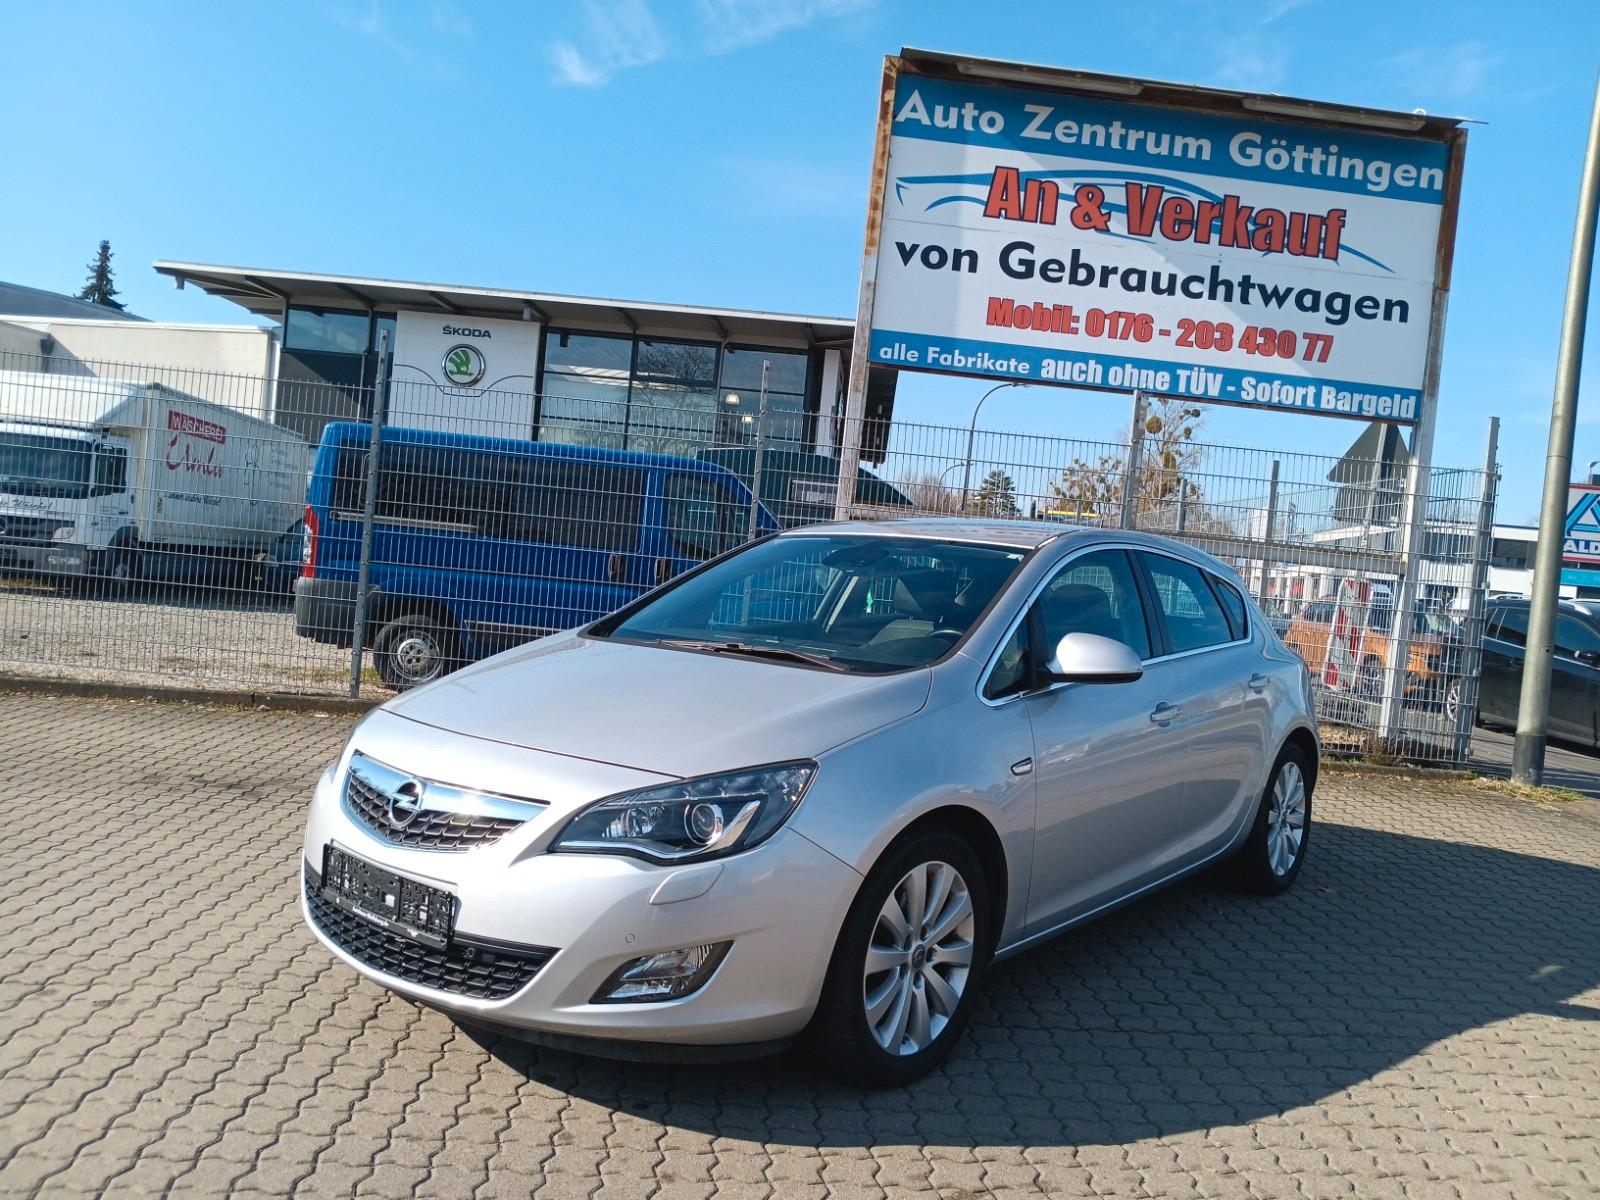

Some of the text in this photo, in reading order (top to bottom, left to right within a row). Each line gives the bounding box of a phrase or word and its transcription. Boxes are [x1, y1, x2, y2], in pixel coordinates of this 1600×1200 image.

[894, 89, 1444, 192] Auto Zentrum Göttingen
[983, 165, 1347, 260] An & Verkauf
[895, 241, 1409, 325] von Gebrauchtwagen
[442, 325, 492, 339] ŠKODA
[986, 296, 1334, 363] Mobil: 0176 - 203 430 77
[880, 342, 918, 361] alle
[927, 347, 1030, 374] Fabrikate
[1040, 358, 1102, 384] auch
[1108, 361, 1170, 391] ohne
[1176, 367, 1223, 396] TÜV
[1240, 377, 1317, 405] Sofort
[1320, 386, 1417, 419] Bargeld
